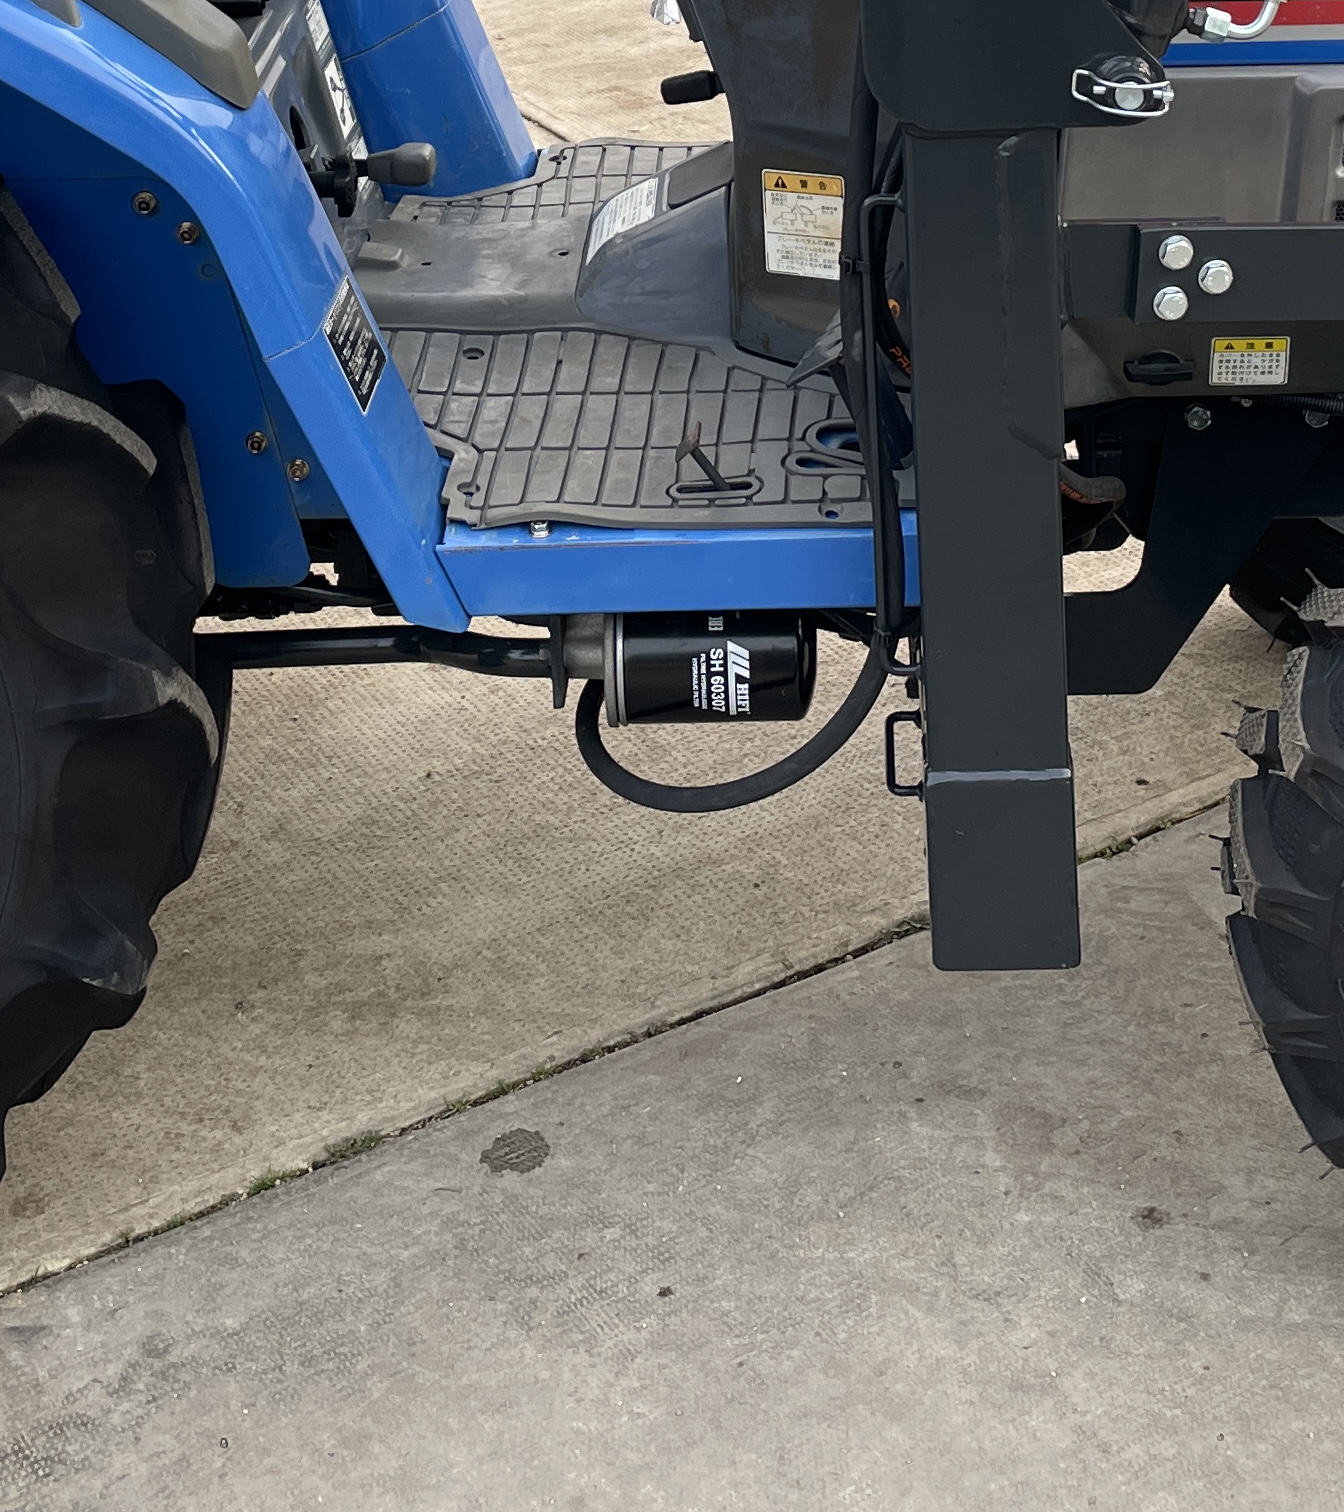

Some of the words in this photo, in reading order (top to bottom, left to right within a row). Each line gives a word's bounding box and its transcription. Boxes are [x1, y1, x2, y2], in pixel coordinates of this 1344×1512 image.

[709, 648, 723, 671] SH
[710, 675, 724, 712] 60307
[736, 683, 749, 711] HIFI
